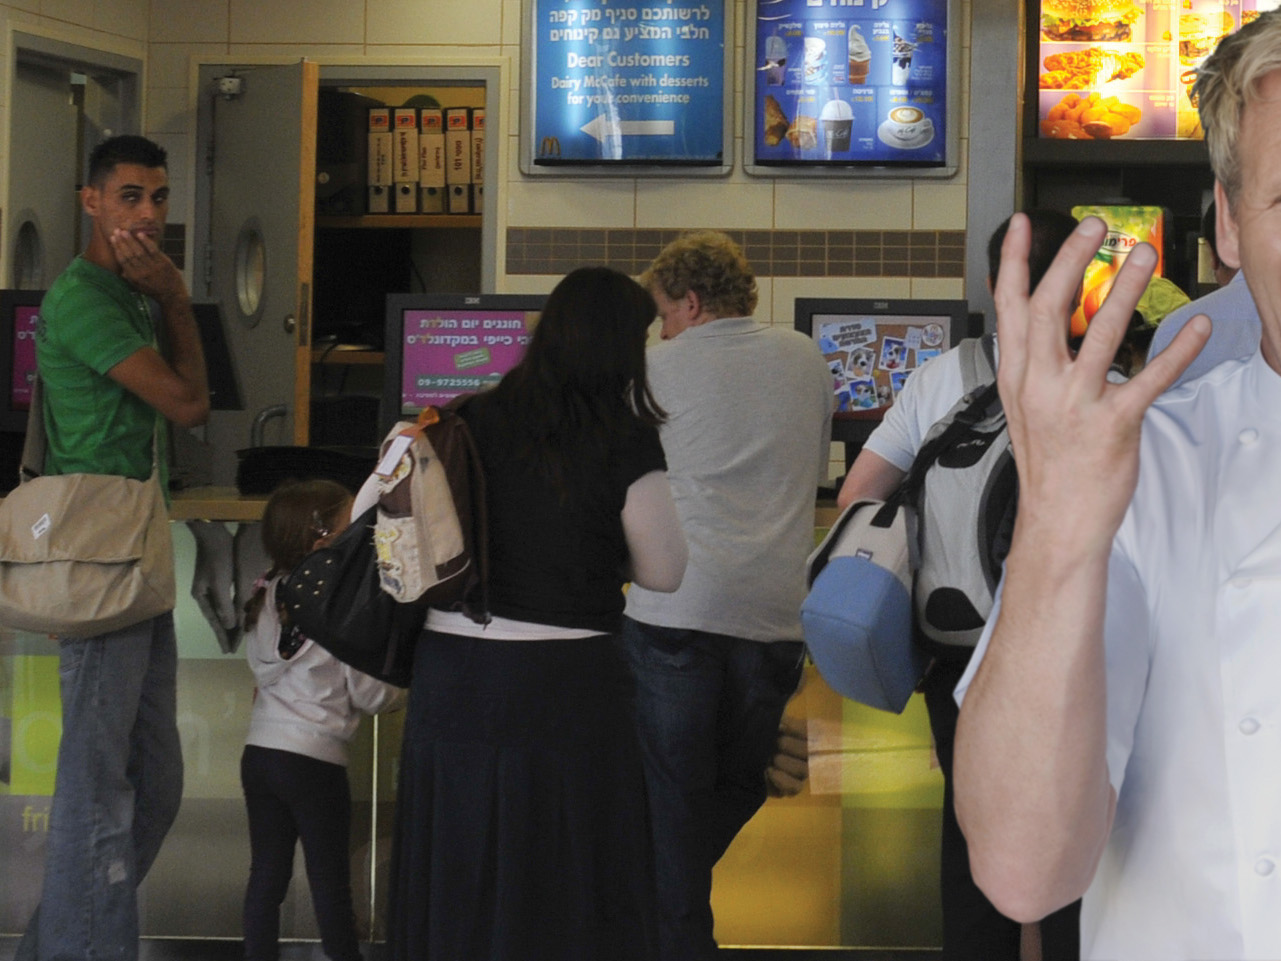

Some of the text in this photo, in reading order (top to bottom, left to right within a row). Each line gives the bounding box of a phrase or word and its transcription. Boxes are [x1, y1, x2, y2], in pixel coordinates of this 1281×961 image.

[549, 5, 711, 25] לרשותכם סניף מק קפה
[550, 27, 599, 44] קינוחים
[602, 28, 620, 40] גם
[624, 26, 672, 41] המציע
[567, 51, 690, 69] Dear Customers
[551, 76, 582, 91] Dairy
[630, 74, 656, 87] with
[659, 74, 709, 88] desserts
[567, 91, 584, 105] for
[617, 90, 690, 104] convenience
[461, 319, 479, 329] יום
